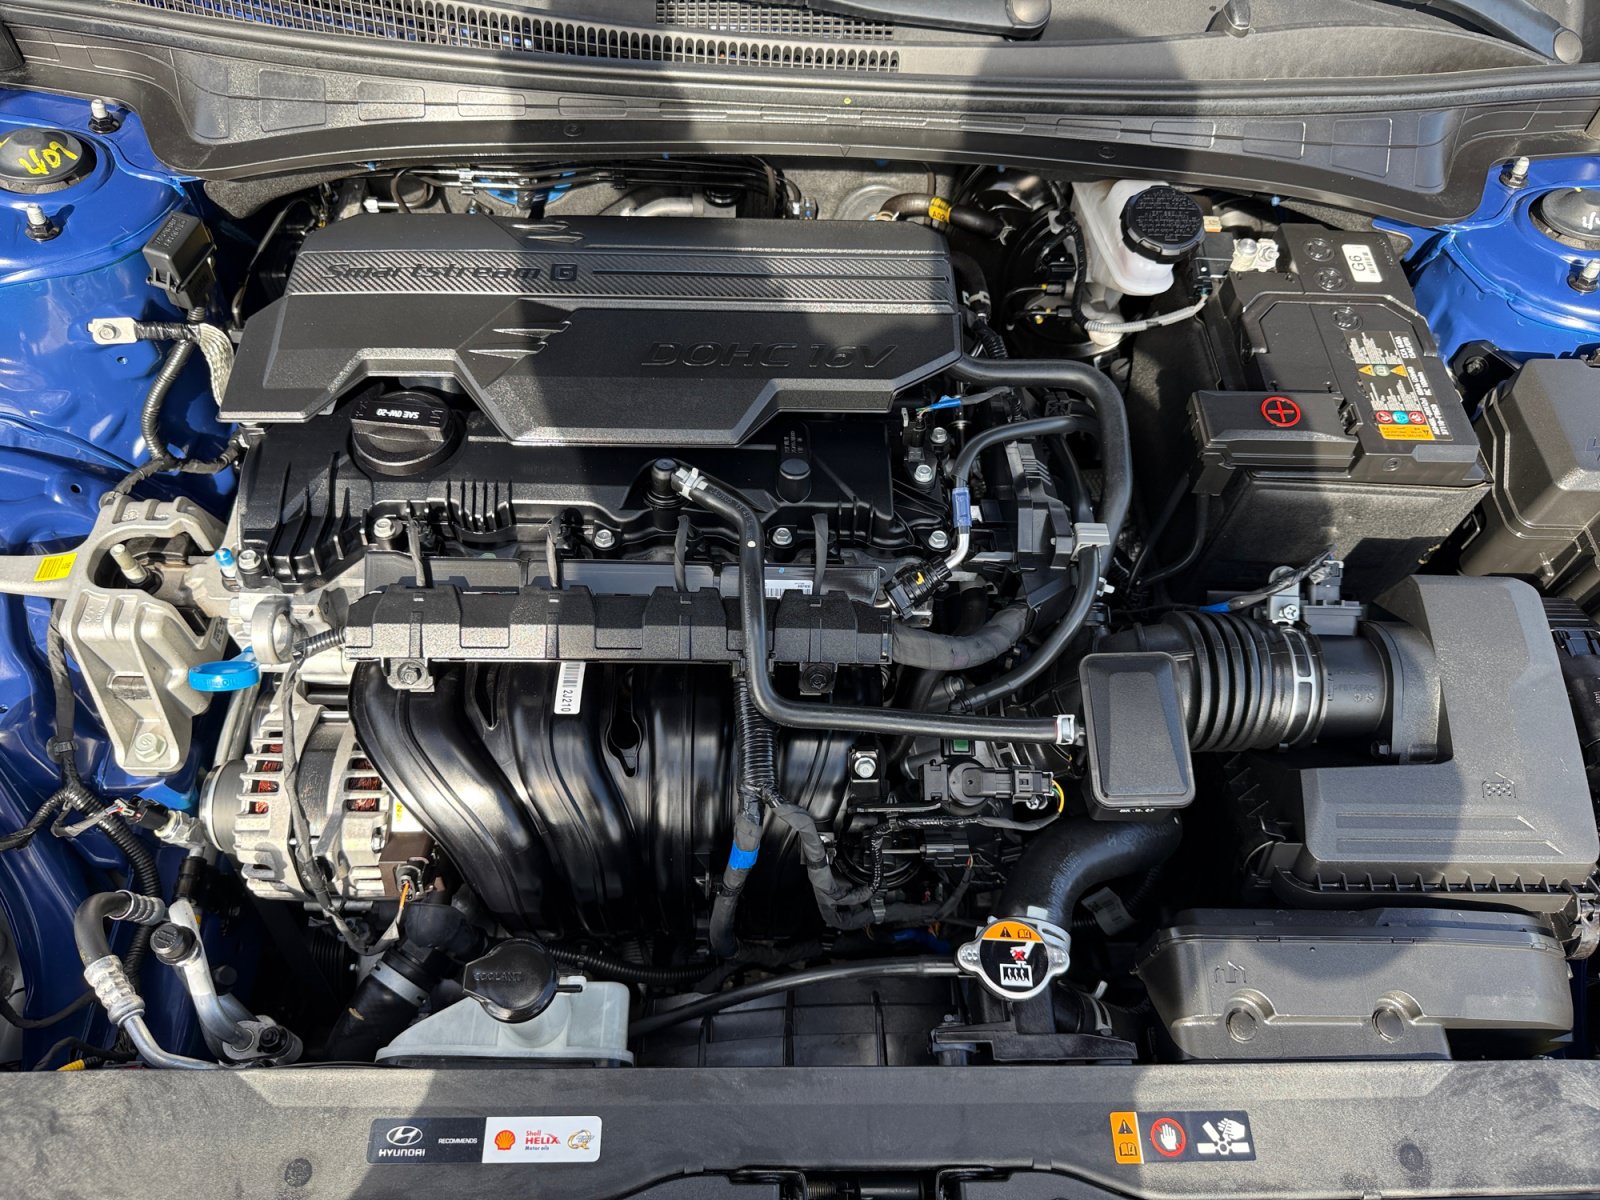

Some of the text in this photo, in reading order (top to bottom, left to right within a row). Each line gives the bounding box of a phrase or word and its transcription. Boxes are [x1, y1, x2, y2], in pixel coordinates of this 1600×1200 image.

[1348, 255, 1366, 272] G6
[320, 263, 542, 281] Smartstream
[640, 341, 898, 369] DOHC 16V
[525, 1129, 542, 1137] Shell
[525, 1136, 559, 1145] HELIX
[378, 1148, 426, 1157] HYUNDAI
